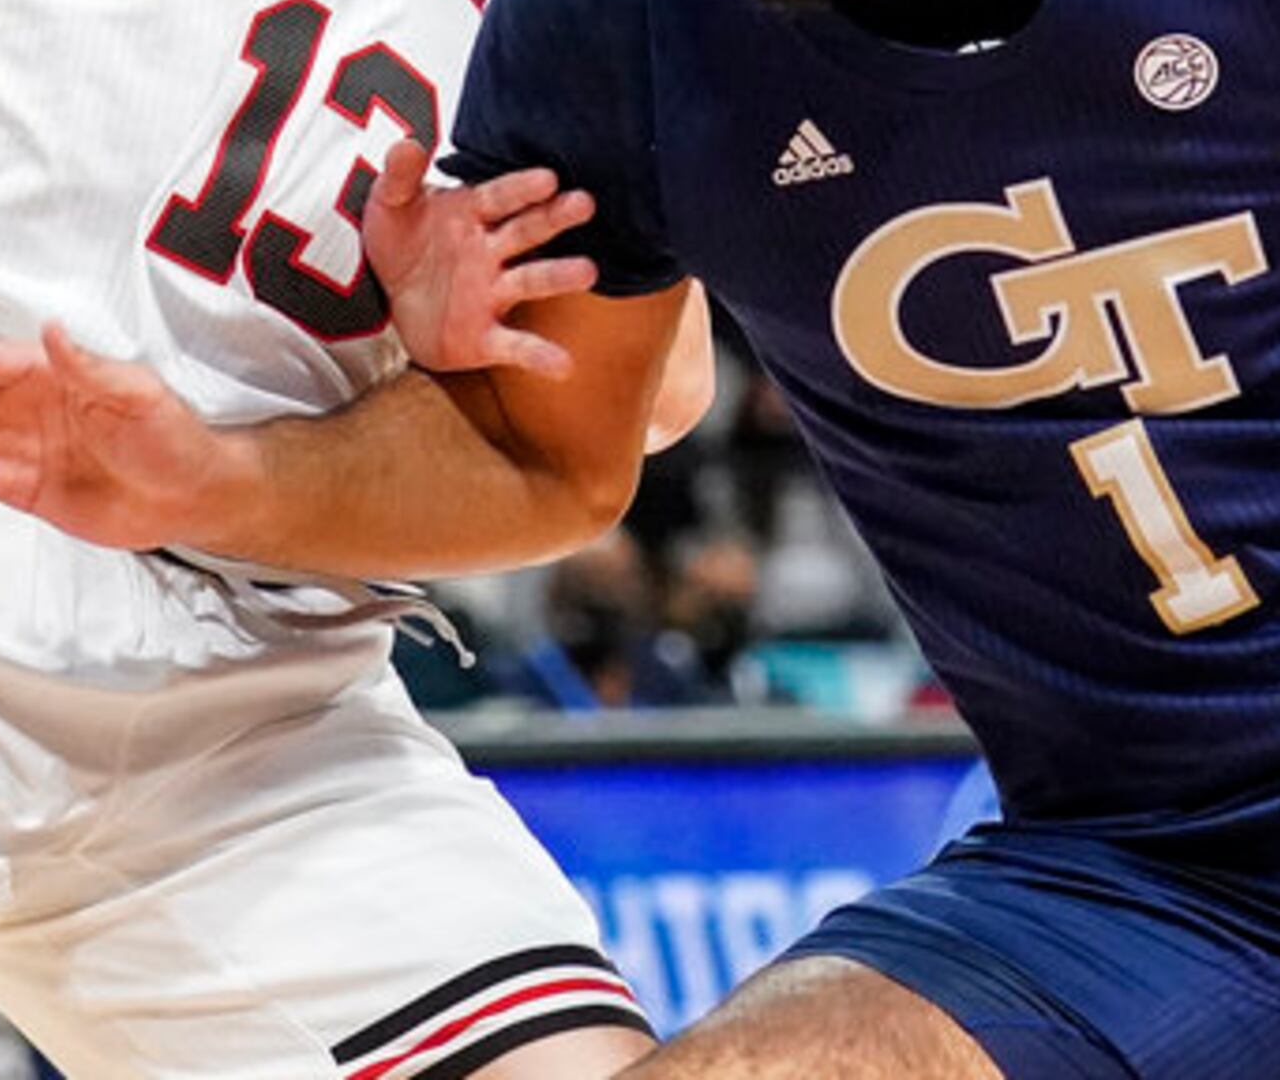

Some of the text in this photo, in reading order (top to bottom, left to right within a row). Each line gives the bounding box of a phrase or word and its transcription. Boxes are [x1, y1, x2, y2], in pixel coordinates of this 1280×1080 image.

[773, 153, 855, 186] adidas
[831, 176, 1269, 417] GT
[1068, 416, 1261, 636] 1
